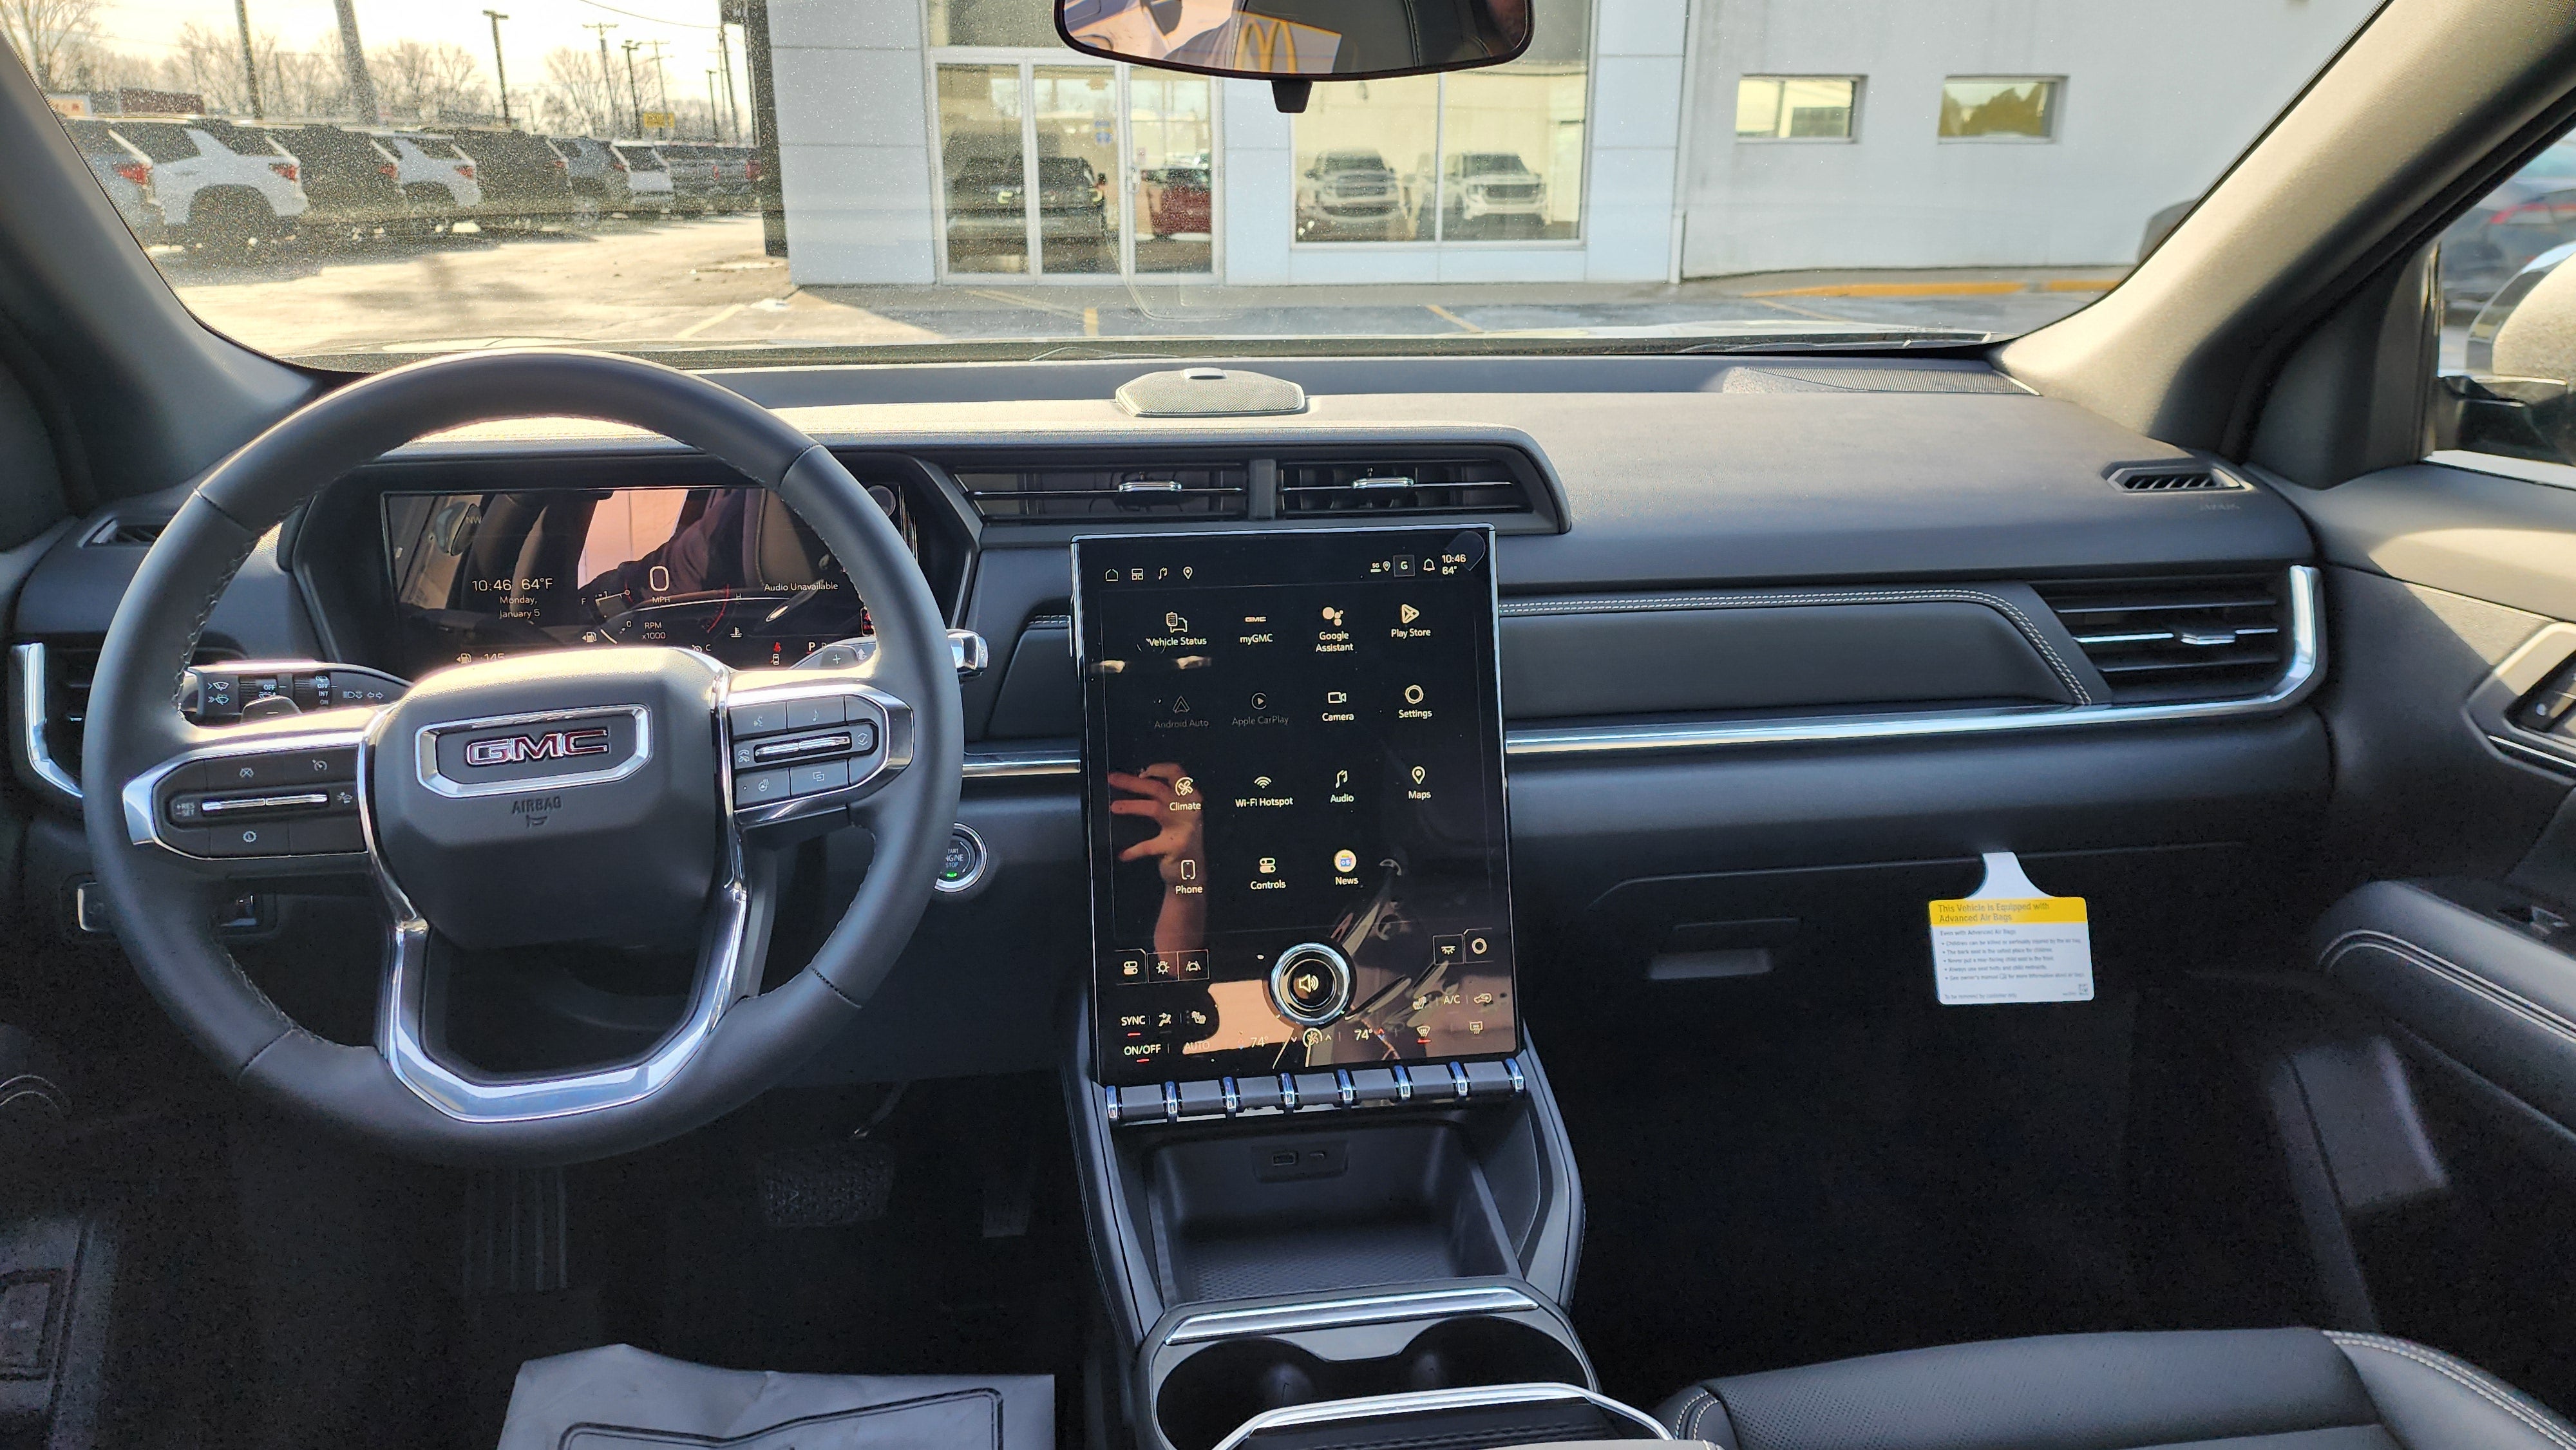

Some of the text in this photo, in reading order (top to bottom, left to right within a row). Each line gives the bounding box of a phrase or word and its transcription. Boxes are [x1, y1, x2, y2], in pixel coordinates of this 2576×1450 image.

[466, 516, 482, 524] NW
[1442, 554, 1466, 563] 10:46
[1401, 561, 1408, 570] G
[649, 565, 669, 592] 0
[471, 578, 554, 592] 10:46 64°F
[764, 582, 838, 592] Audio Unavailable
[499, 594, 538, 606] Monday,
[499, 608, 540, 619] January 5
[642, 632, 666, 640] x1000
[1319, 631, 1349, 642] Google
[1391, 628, 1431, 639] Play Store
[1148, 636, 1207, 646] Vehicle Status
[1240, 634, 1273, 646] myGMC
[808, 642, 816, 652] P
[1316, 643, 1354, 653] Assistant
[1322, 713, 1354, 722] Camera
[1398, 710, 1432, 719] Settings
[1154, 719, 1209, 729] Android Auto
[1231, 715, 1289, 726] Apple CarPlay
[466, 729, 609, 766] GMC
[1330, 793, 1354, 803] Audio
[1408, 791, 1432, 800] Maps
[511, 796, 562, 814] AIRBAG
[1169, 802, 1202, 811] Climate
[1235, 797, 1294, 808] Wi-Fi Hotspot
[1250, 880, 1287, 890] Controls
[1335, 876, 1359, 885] News
[1175, 885, 1203, 895] Phone
[1938, 905, 1955, 913] This
[1996, 903, 2031, 912] Equipped
[1993, 913, 2012, 922] Bags
[1443, 995, 1461, 1004] A/C
[1121, 1015, 1146, 1026] SYNC
[1124, 1044, 1161, 1056] ON/OFF
[1184, 1041, 1210, 1051] AUTO
